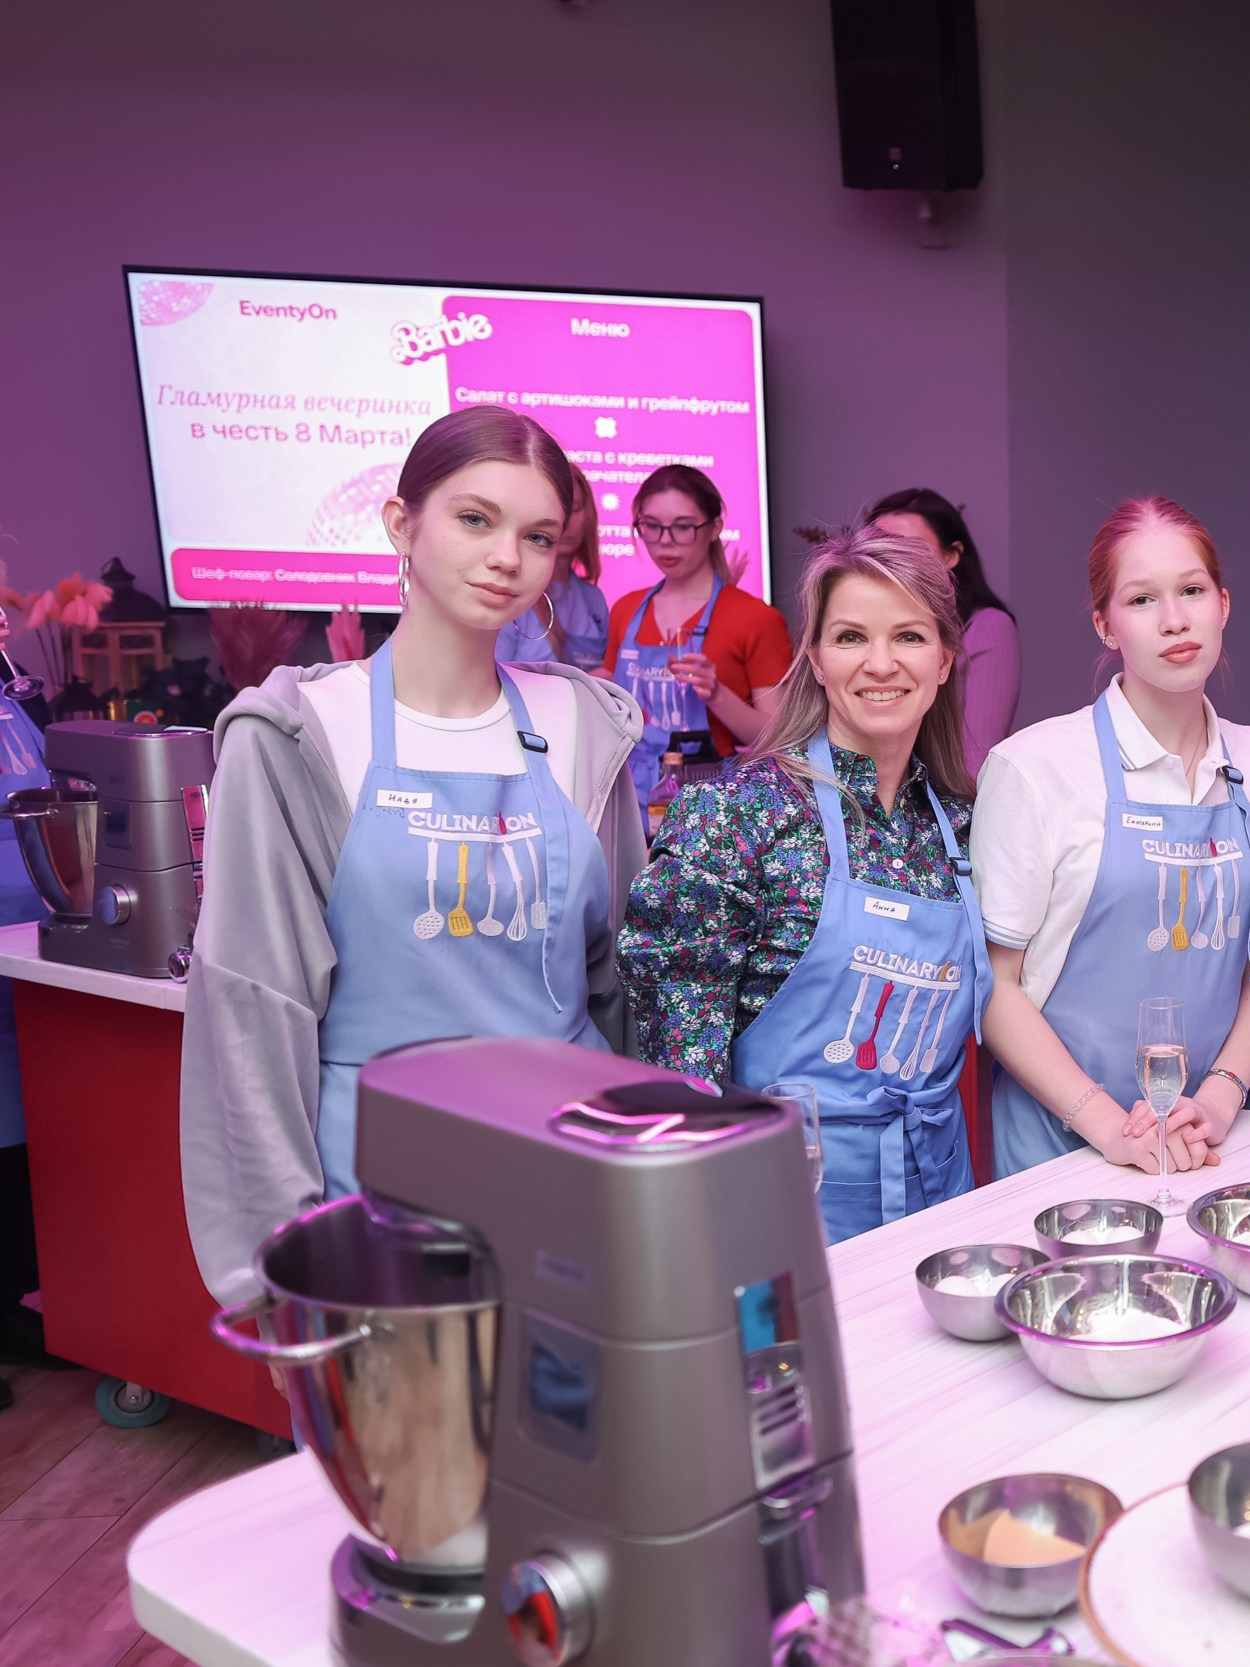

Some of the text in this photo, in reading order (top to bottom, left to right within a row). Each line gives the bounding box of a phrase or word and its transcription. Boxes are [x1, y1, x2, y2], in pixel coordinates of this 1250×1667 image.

[239, 300, 337, 322] EventyOn
[390, 311, 493, 364] Barbie
[570, 317, 630, 338] Меню
[157, 384, 432, 419] Гламурная вечеринка
[455, 386, 750, 416] Салат с артишоками и грейпфрутом
[191, 422, 412, 449] в честь 8 Марта!
[564, 450, 603, 464] аста
[617, 451, 715, 468] креветками
